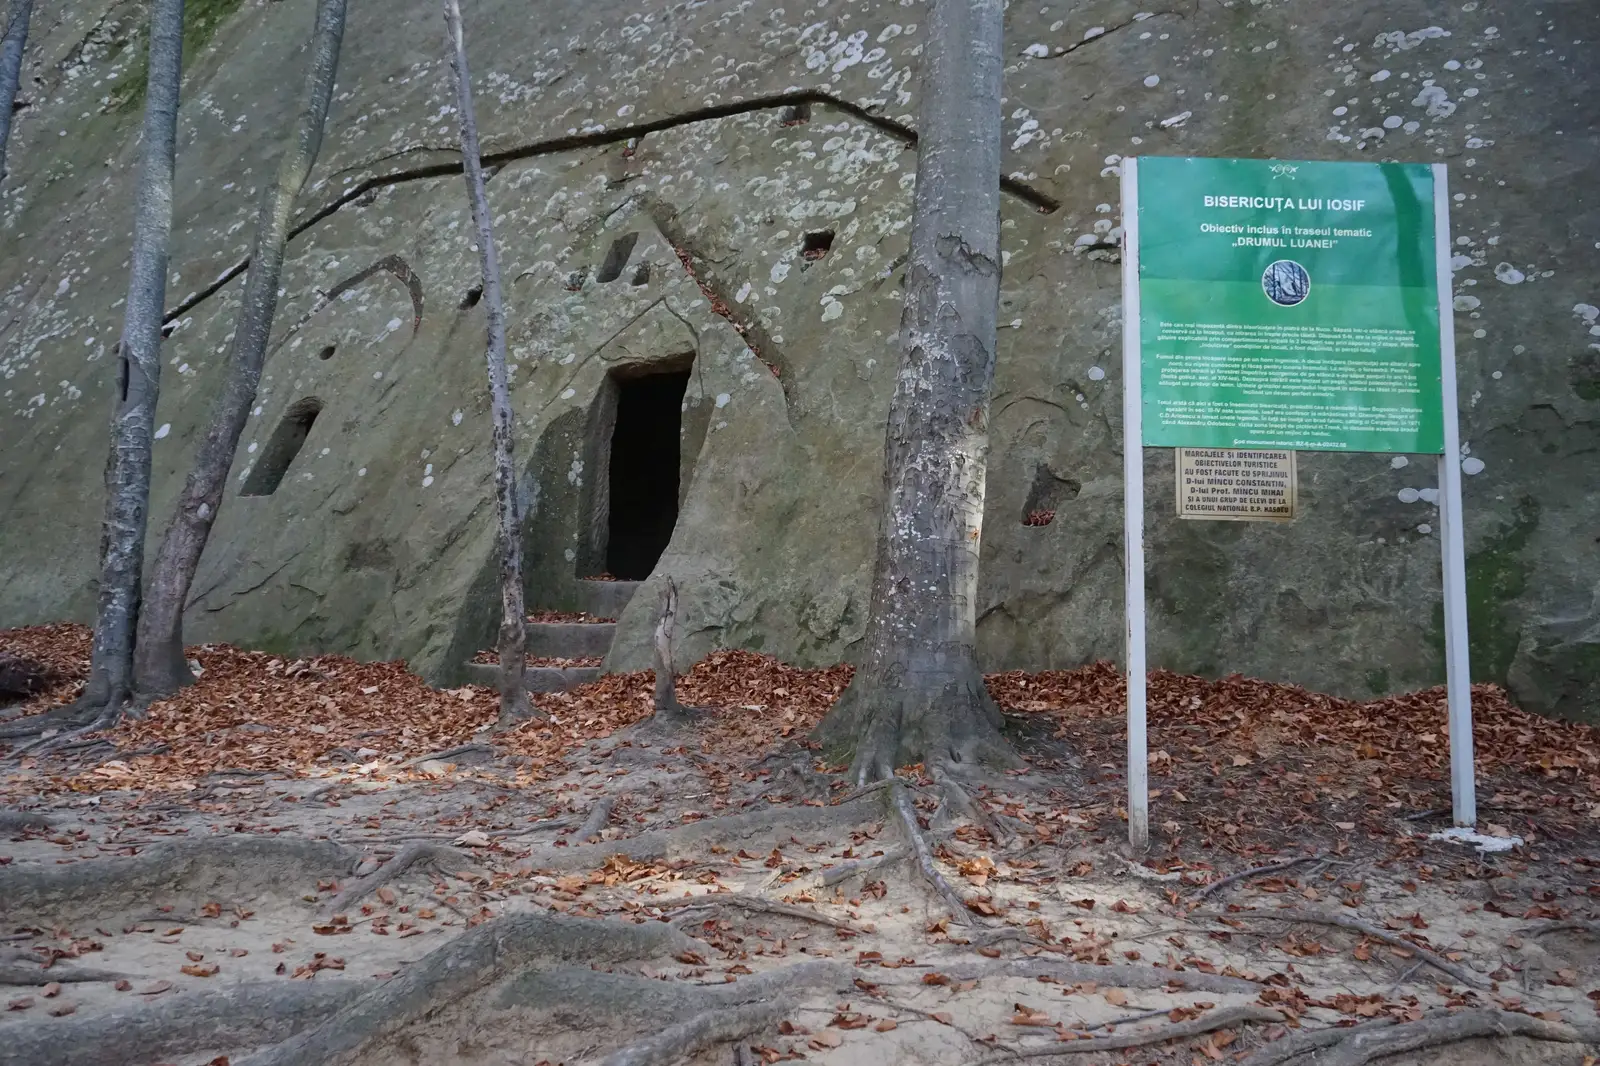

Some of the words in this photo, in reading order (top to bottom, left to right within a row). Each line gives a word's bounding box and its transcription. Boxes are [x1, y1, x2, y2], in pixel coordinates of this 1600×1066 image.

[1298, 198, 1322, 210] LUI
[1327, 199, 1366, 211] IOSIF
[1200, 223, 1245, 233] Obiectiv
[1247, 225, 1279, 234] inclus
[1281, 225, 1292, 235] în
[1294, 227, 1331, 236] traseul
[1333, 228, 1373, 238] tematic
[1236, 452, 1287, 460] IDENTIFICAREA
